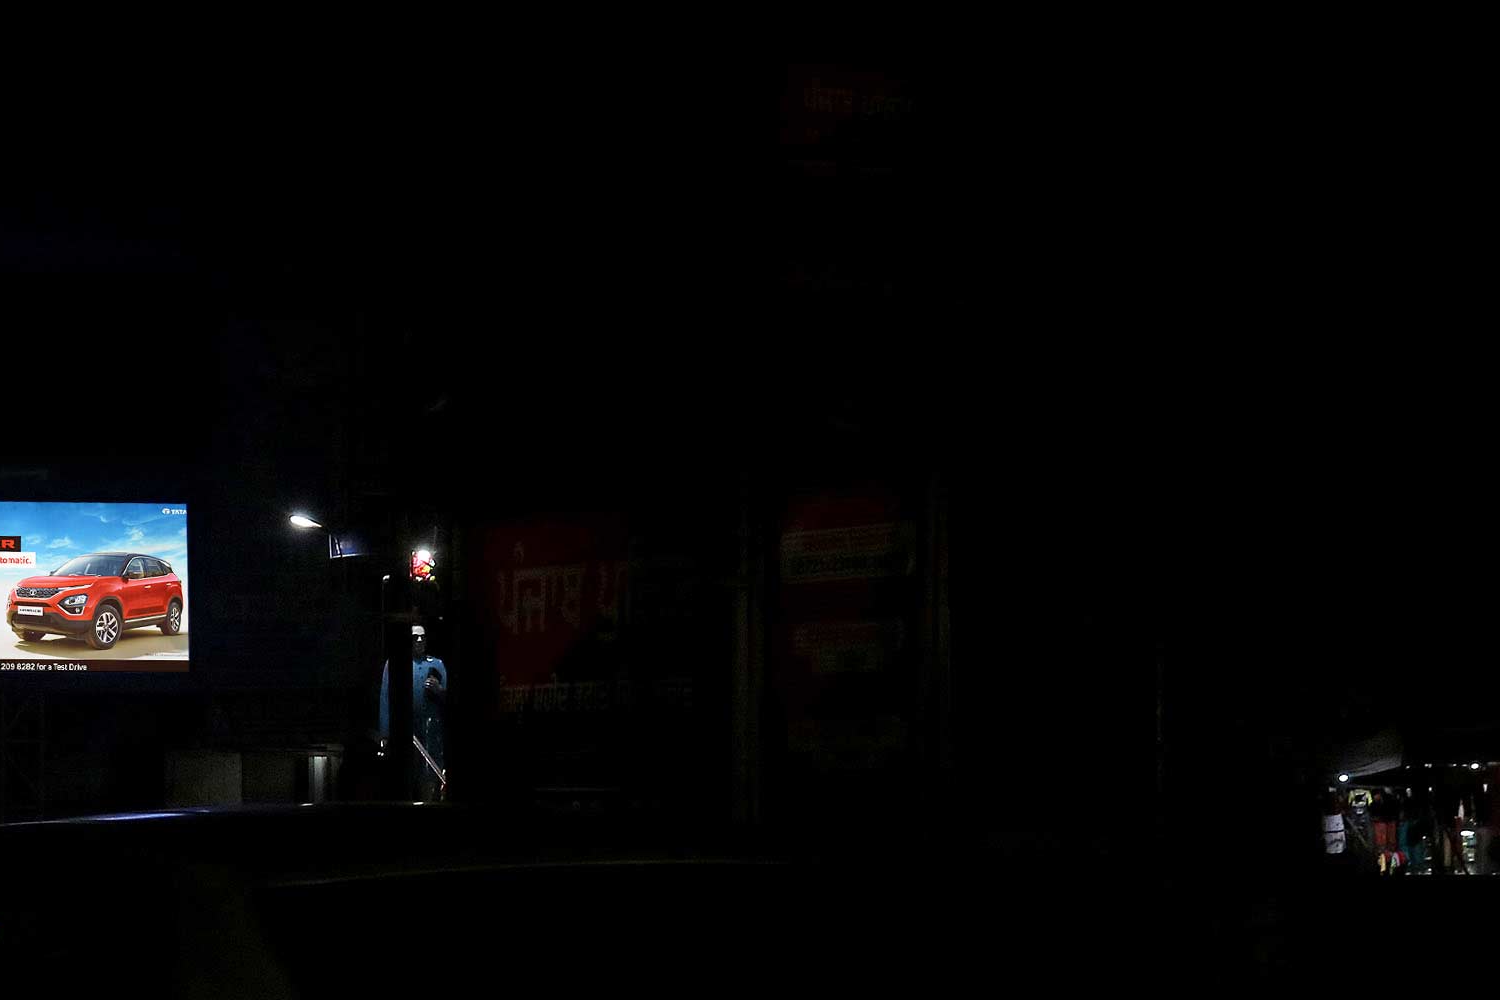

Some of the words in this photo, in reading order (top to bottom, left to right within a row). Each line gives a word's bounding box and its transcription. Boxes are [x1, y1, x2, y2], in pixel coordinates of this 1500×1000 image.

[1, 663, 15, 671] 209
[16, 663, 36, 671] 8282
[36, 663, 47, 671] for
[53, 663, 68, 671] Test
[68, 663, 88, 671] Drive
